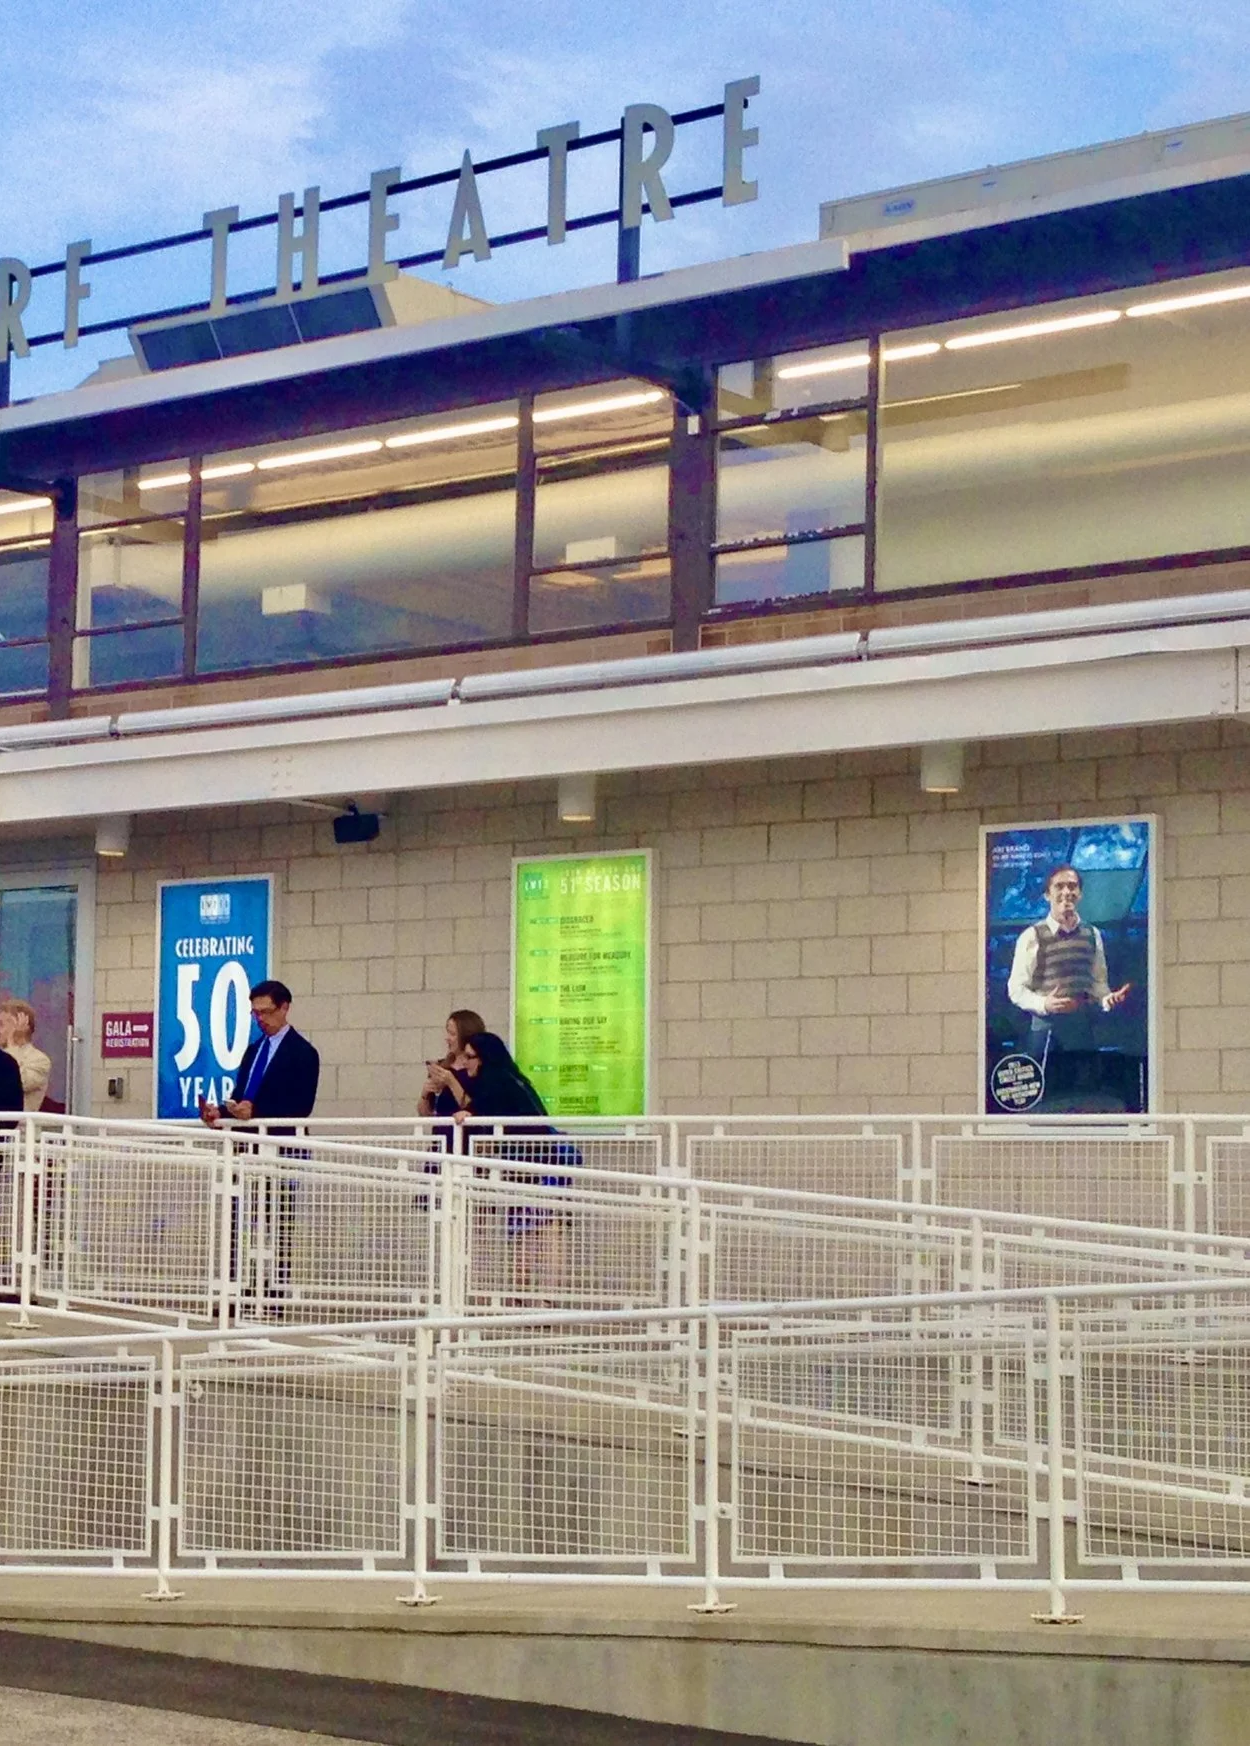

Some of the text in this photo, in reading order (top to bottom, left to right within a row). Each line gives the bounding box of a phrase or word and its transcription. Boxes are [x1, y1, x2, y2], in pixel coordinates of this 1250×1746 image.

[202, 74, 761, 312] THEATRE
[584, 873, 641, 893] SEASON
[175, 936, 254, 957] CELEBRATING
[173, 960, 252, 1072] 50
[105, 1020, 132, 1036] GALA
